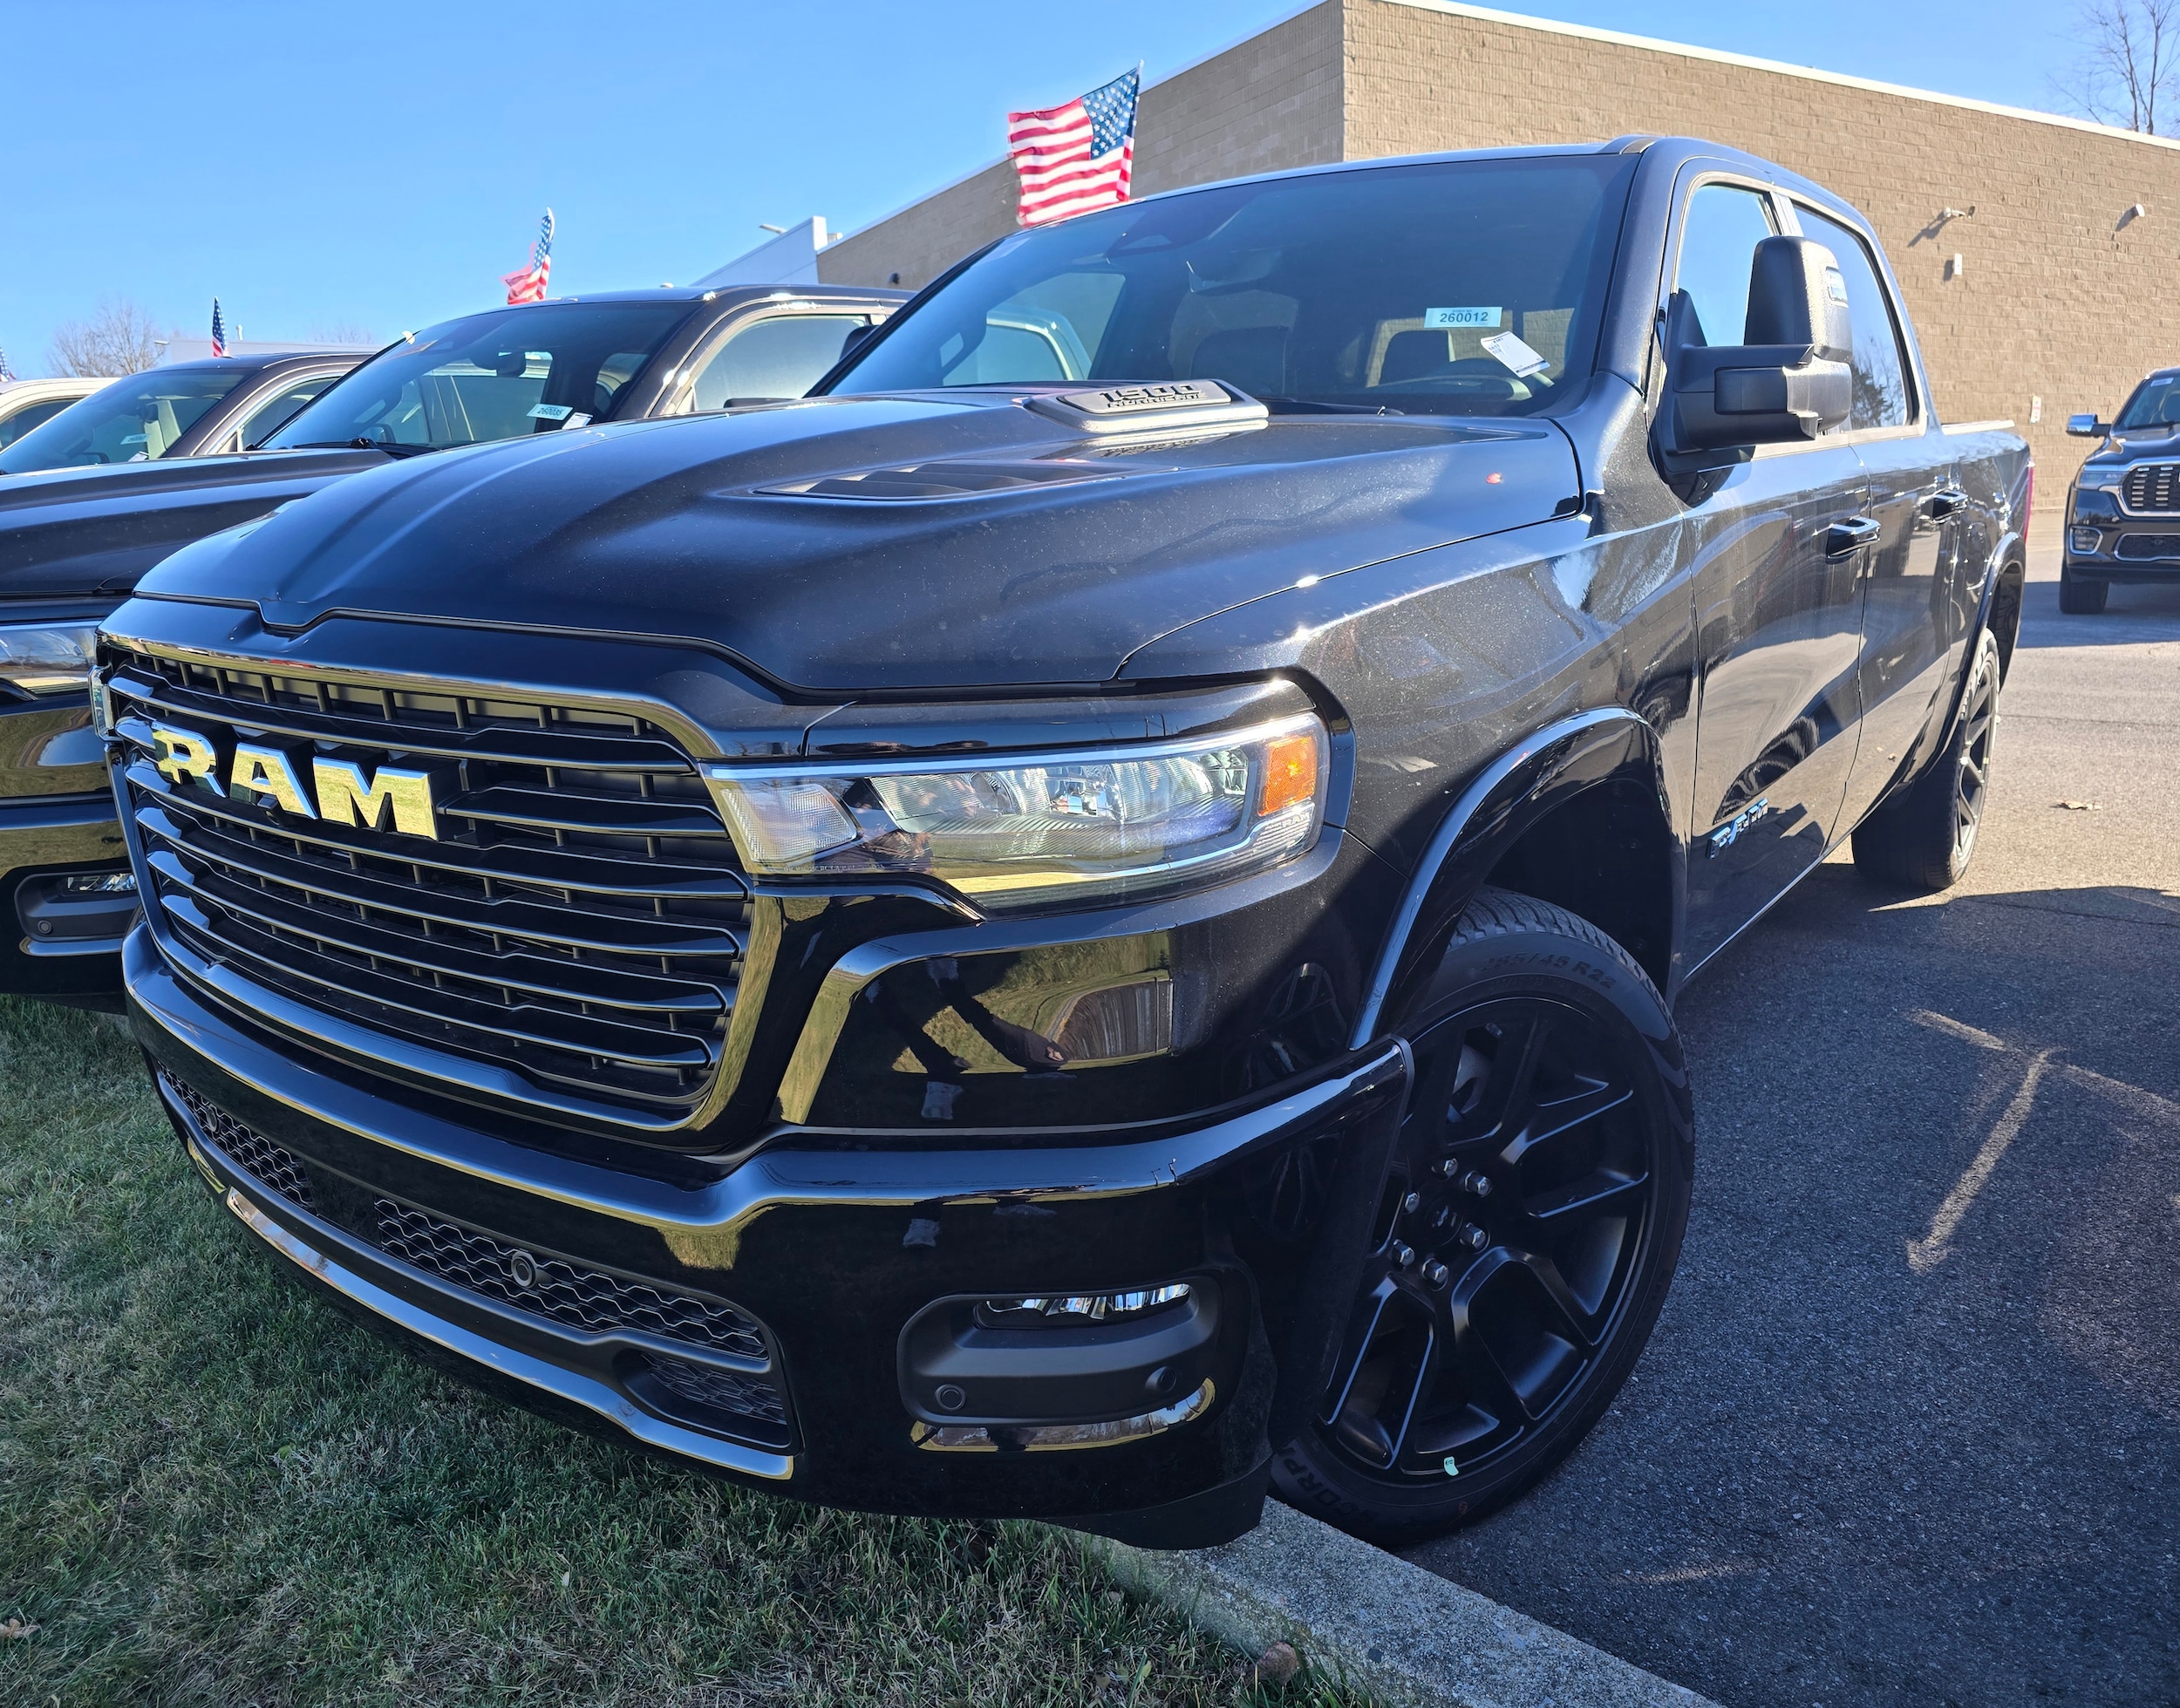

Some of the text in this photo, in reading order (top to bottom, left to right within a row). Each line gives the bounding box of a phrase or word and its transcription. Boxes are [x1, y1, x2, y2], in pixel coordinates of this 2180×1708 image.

[1439, 311, 1489, 323] 260012
[1100, 384, 1201, 403] 1500
[151, 718, 439, 842] RAM
[1572, 960, 1617, 990] R22
